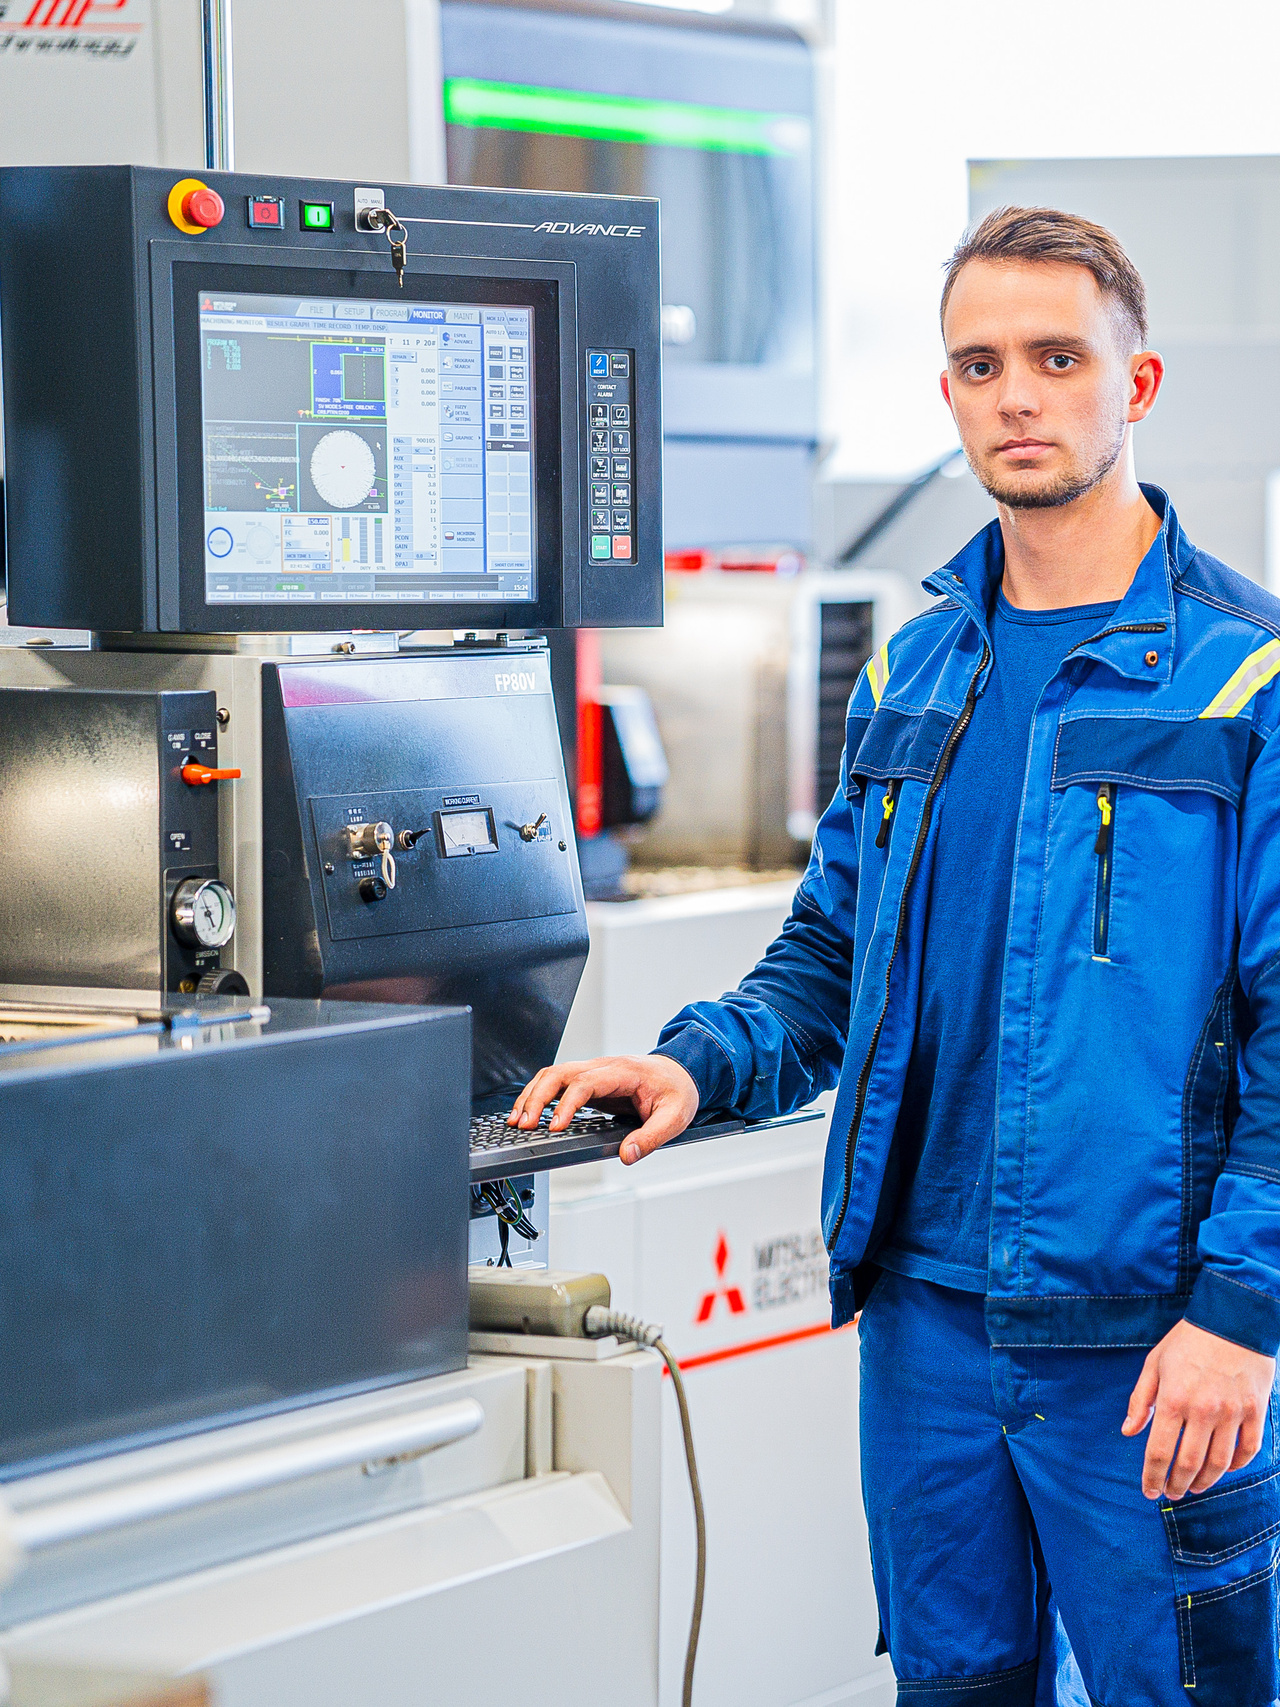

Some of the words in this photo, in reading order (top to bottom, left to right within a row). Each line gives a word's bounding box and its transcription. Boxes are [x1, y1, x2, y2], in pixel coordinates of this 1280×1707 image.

[533, 221, 647, 237] ADVANCE
[309, 305, 324, 314] FILE
[344, 307, 365, 316] SETUP
[376, 309, 407, 317] PROGRAM
[412, 311, 443, 320] MONITOR
[453, 312, 474, 320] MAINT
[328, 322, 351, 330] RECORD
[494, 672, 536, 692] FP80V
